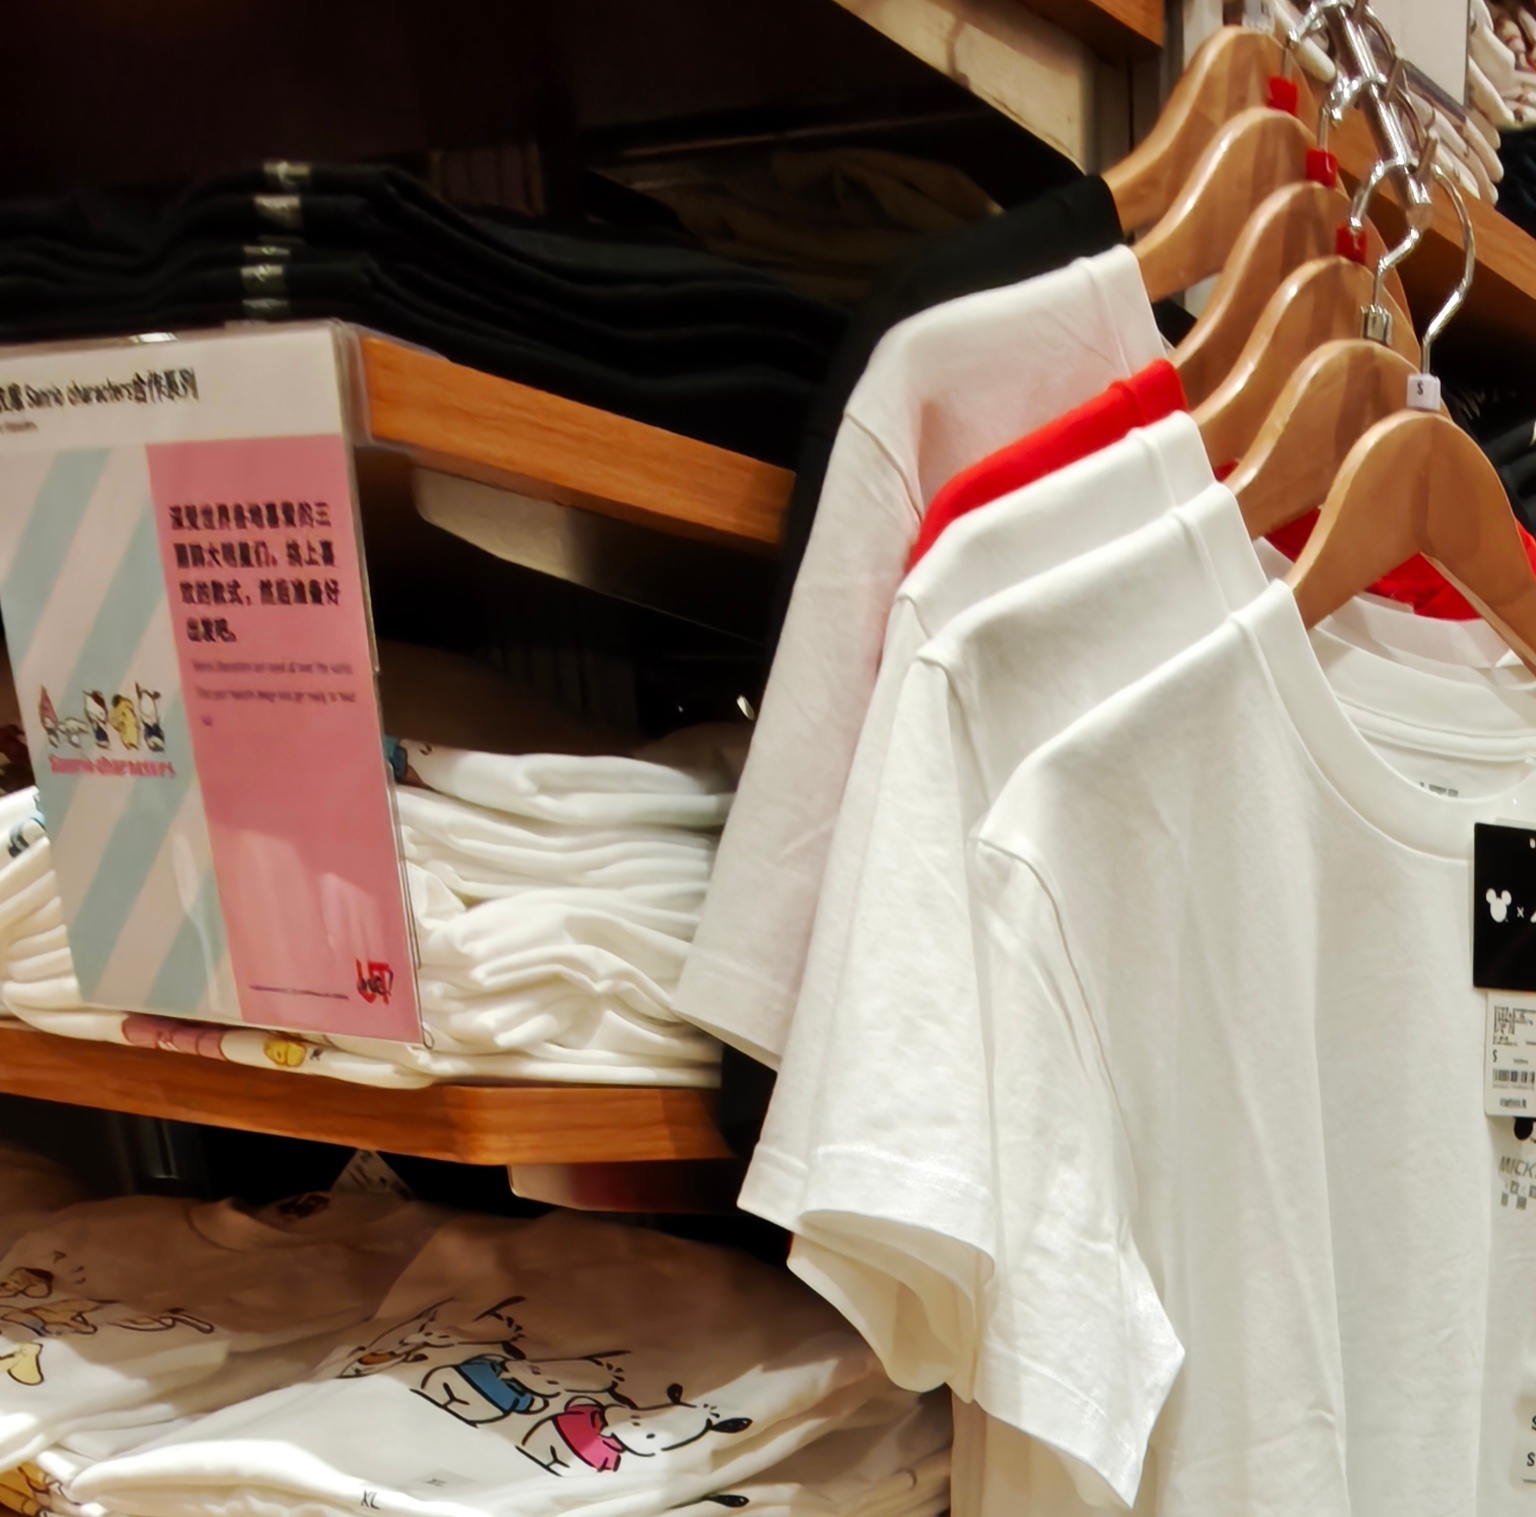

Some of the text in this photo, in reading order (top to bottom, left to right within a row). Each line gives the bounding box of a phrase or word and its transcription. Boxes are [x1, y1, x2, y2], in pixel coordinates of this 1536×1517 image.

[1417, 381, 1424, 395] S
[1526, 1452, 1536, 1467] S
[360, 1489, 381, 1510] XL
